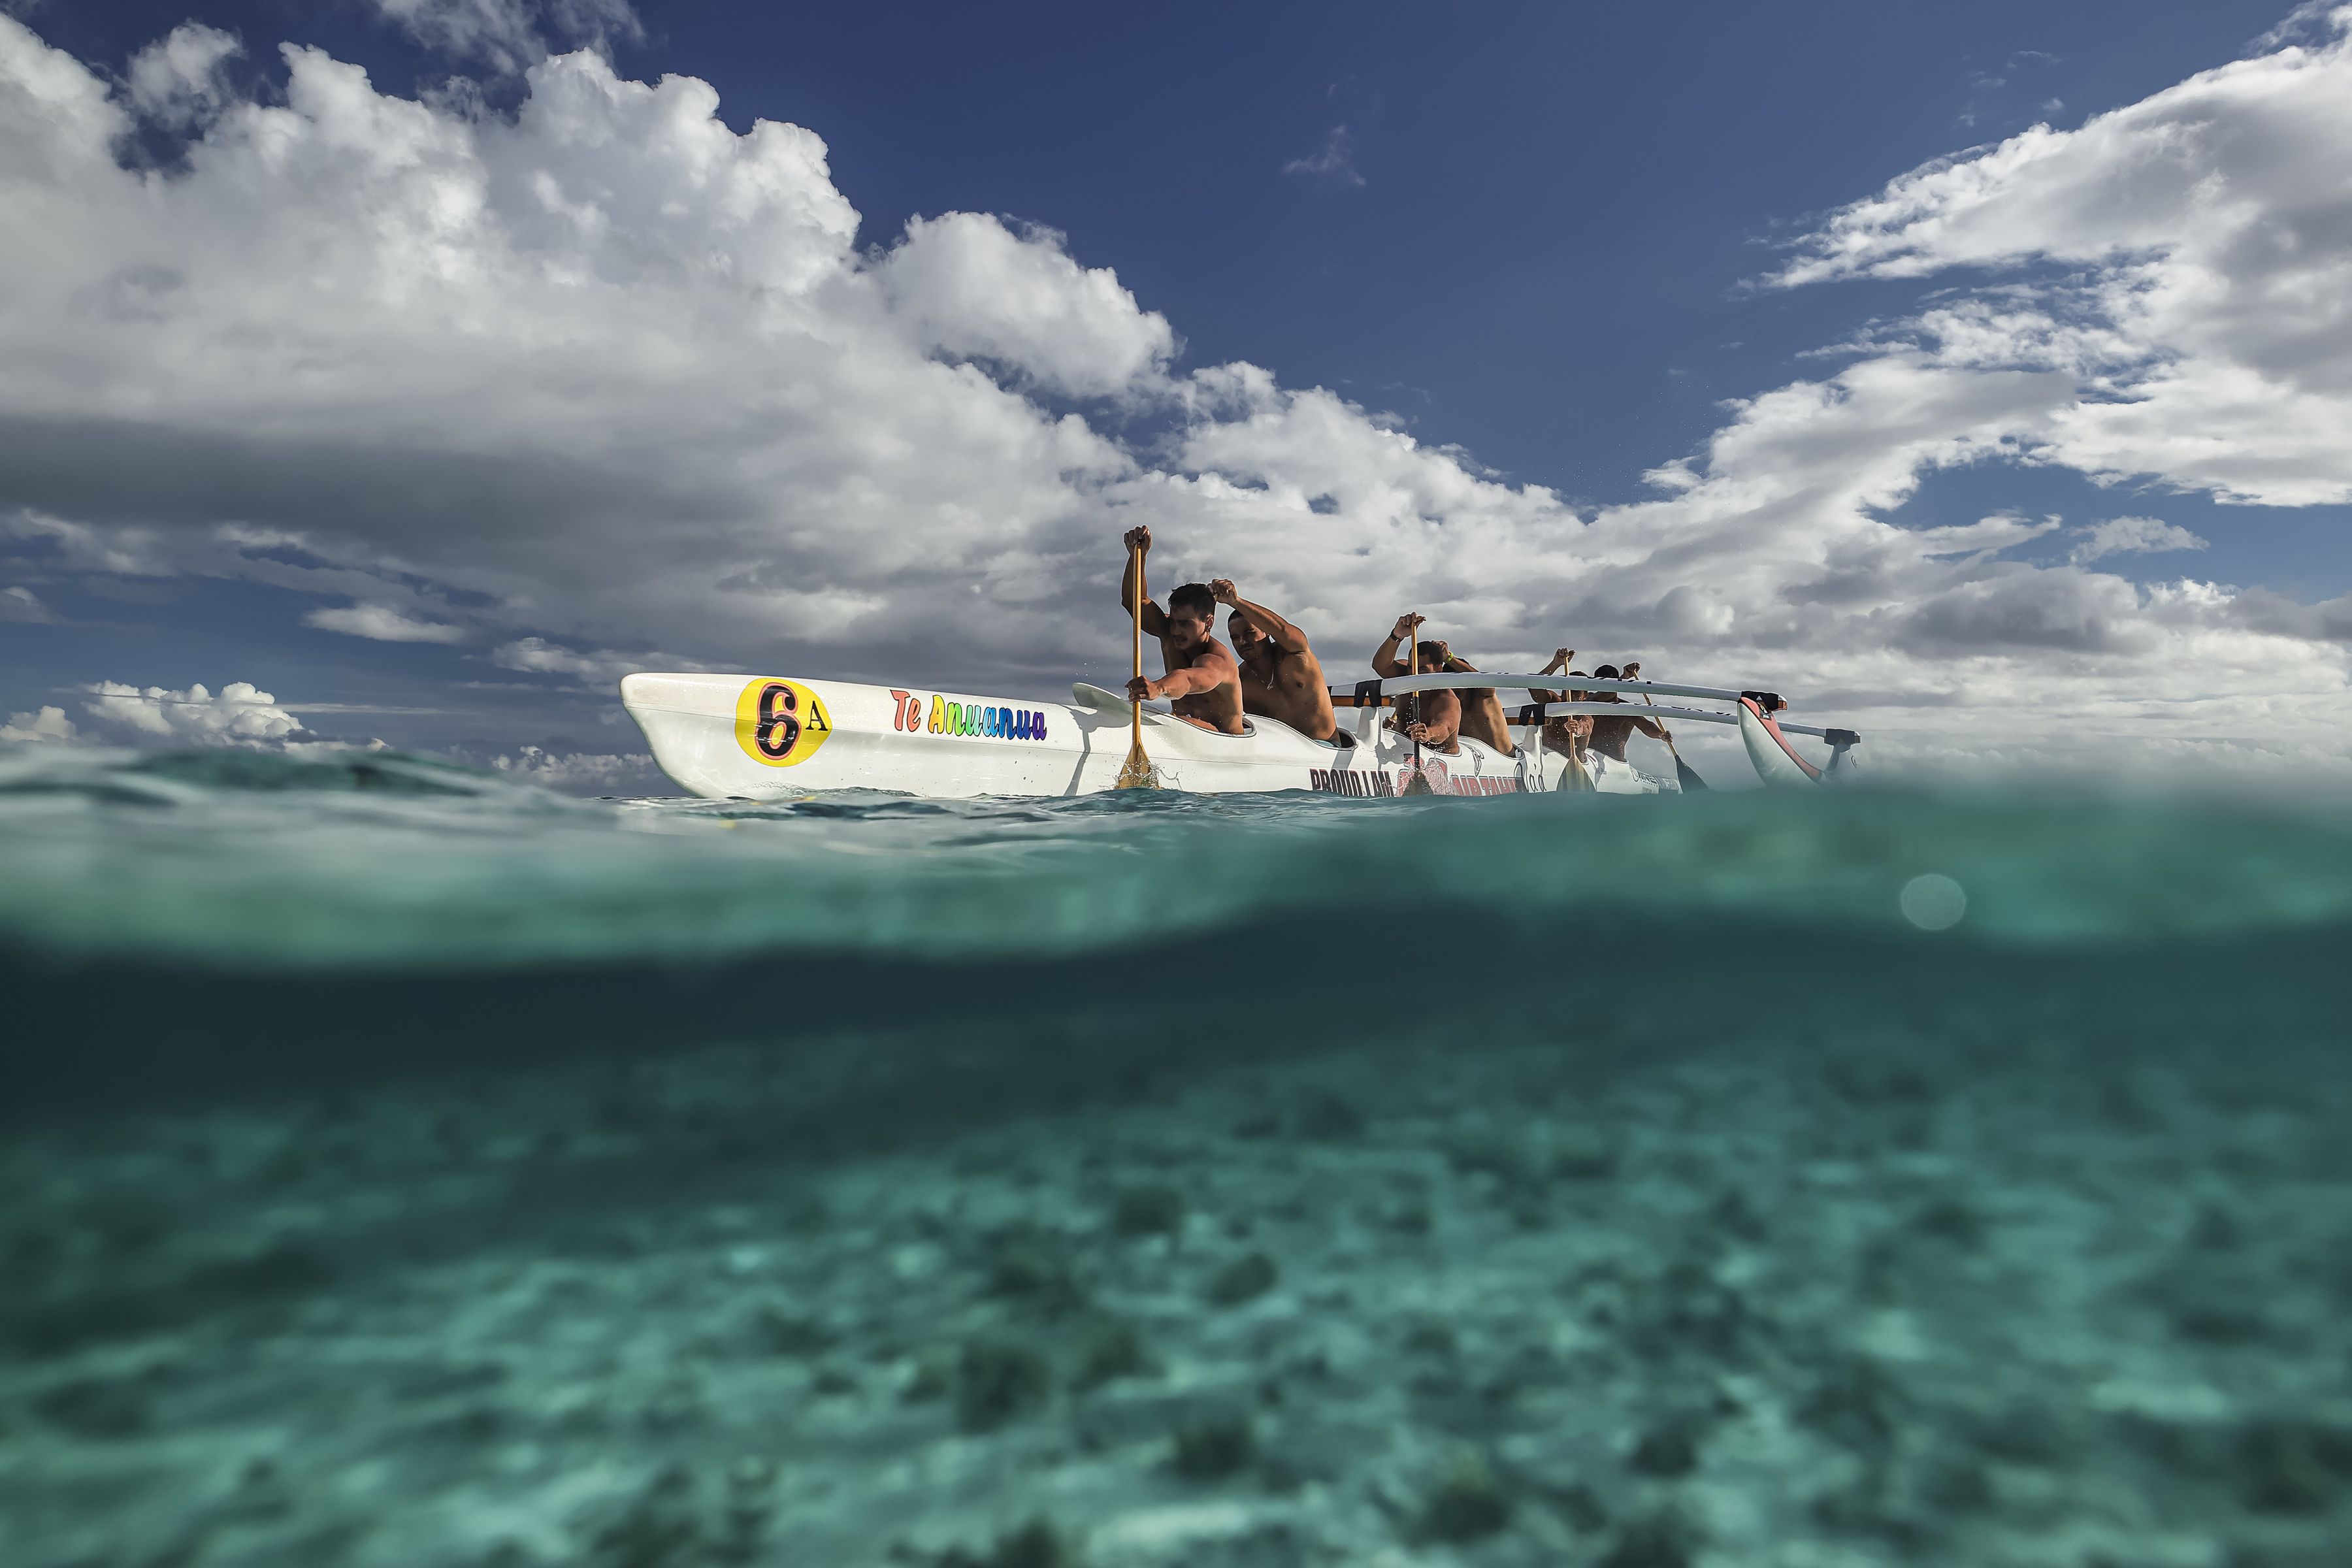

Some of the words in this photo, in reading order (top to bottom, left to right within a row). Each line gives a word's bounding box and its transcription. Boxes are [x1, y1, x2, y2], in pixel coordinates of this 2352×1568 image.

[755, 682, 802, 760] 6
[805, 700, 828, 731] A
[889, 689, 921, 732] Te
[928, 694, 1047, 741] Anuanua
[1309, 768, 1363, 796] PROUD
